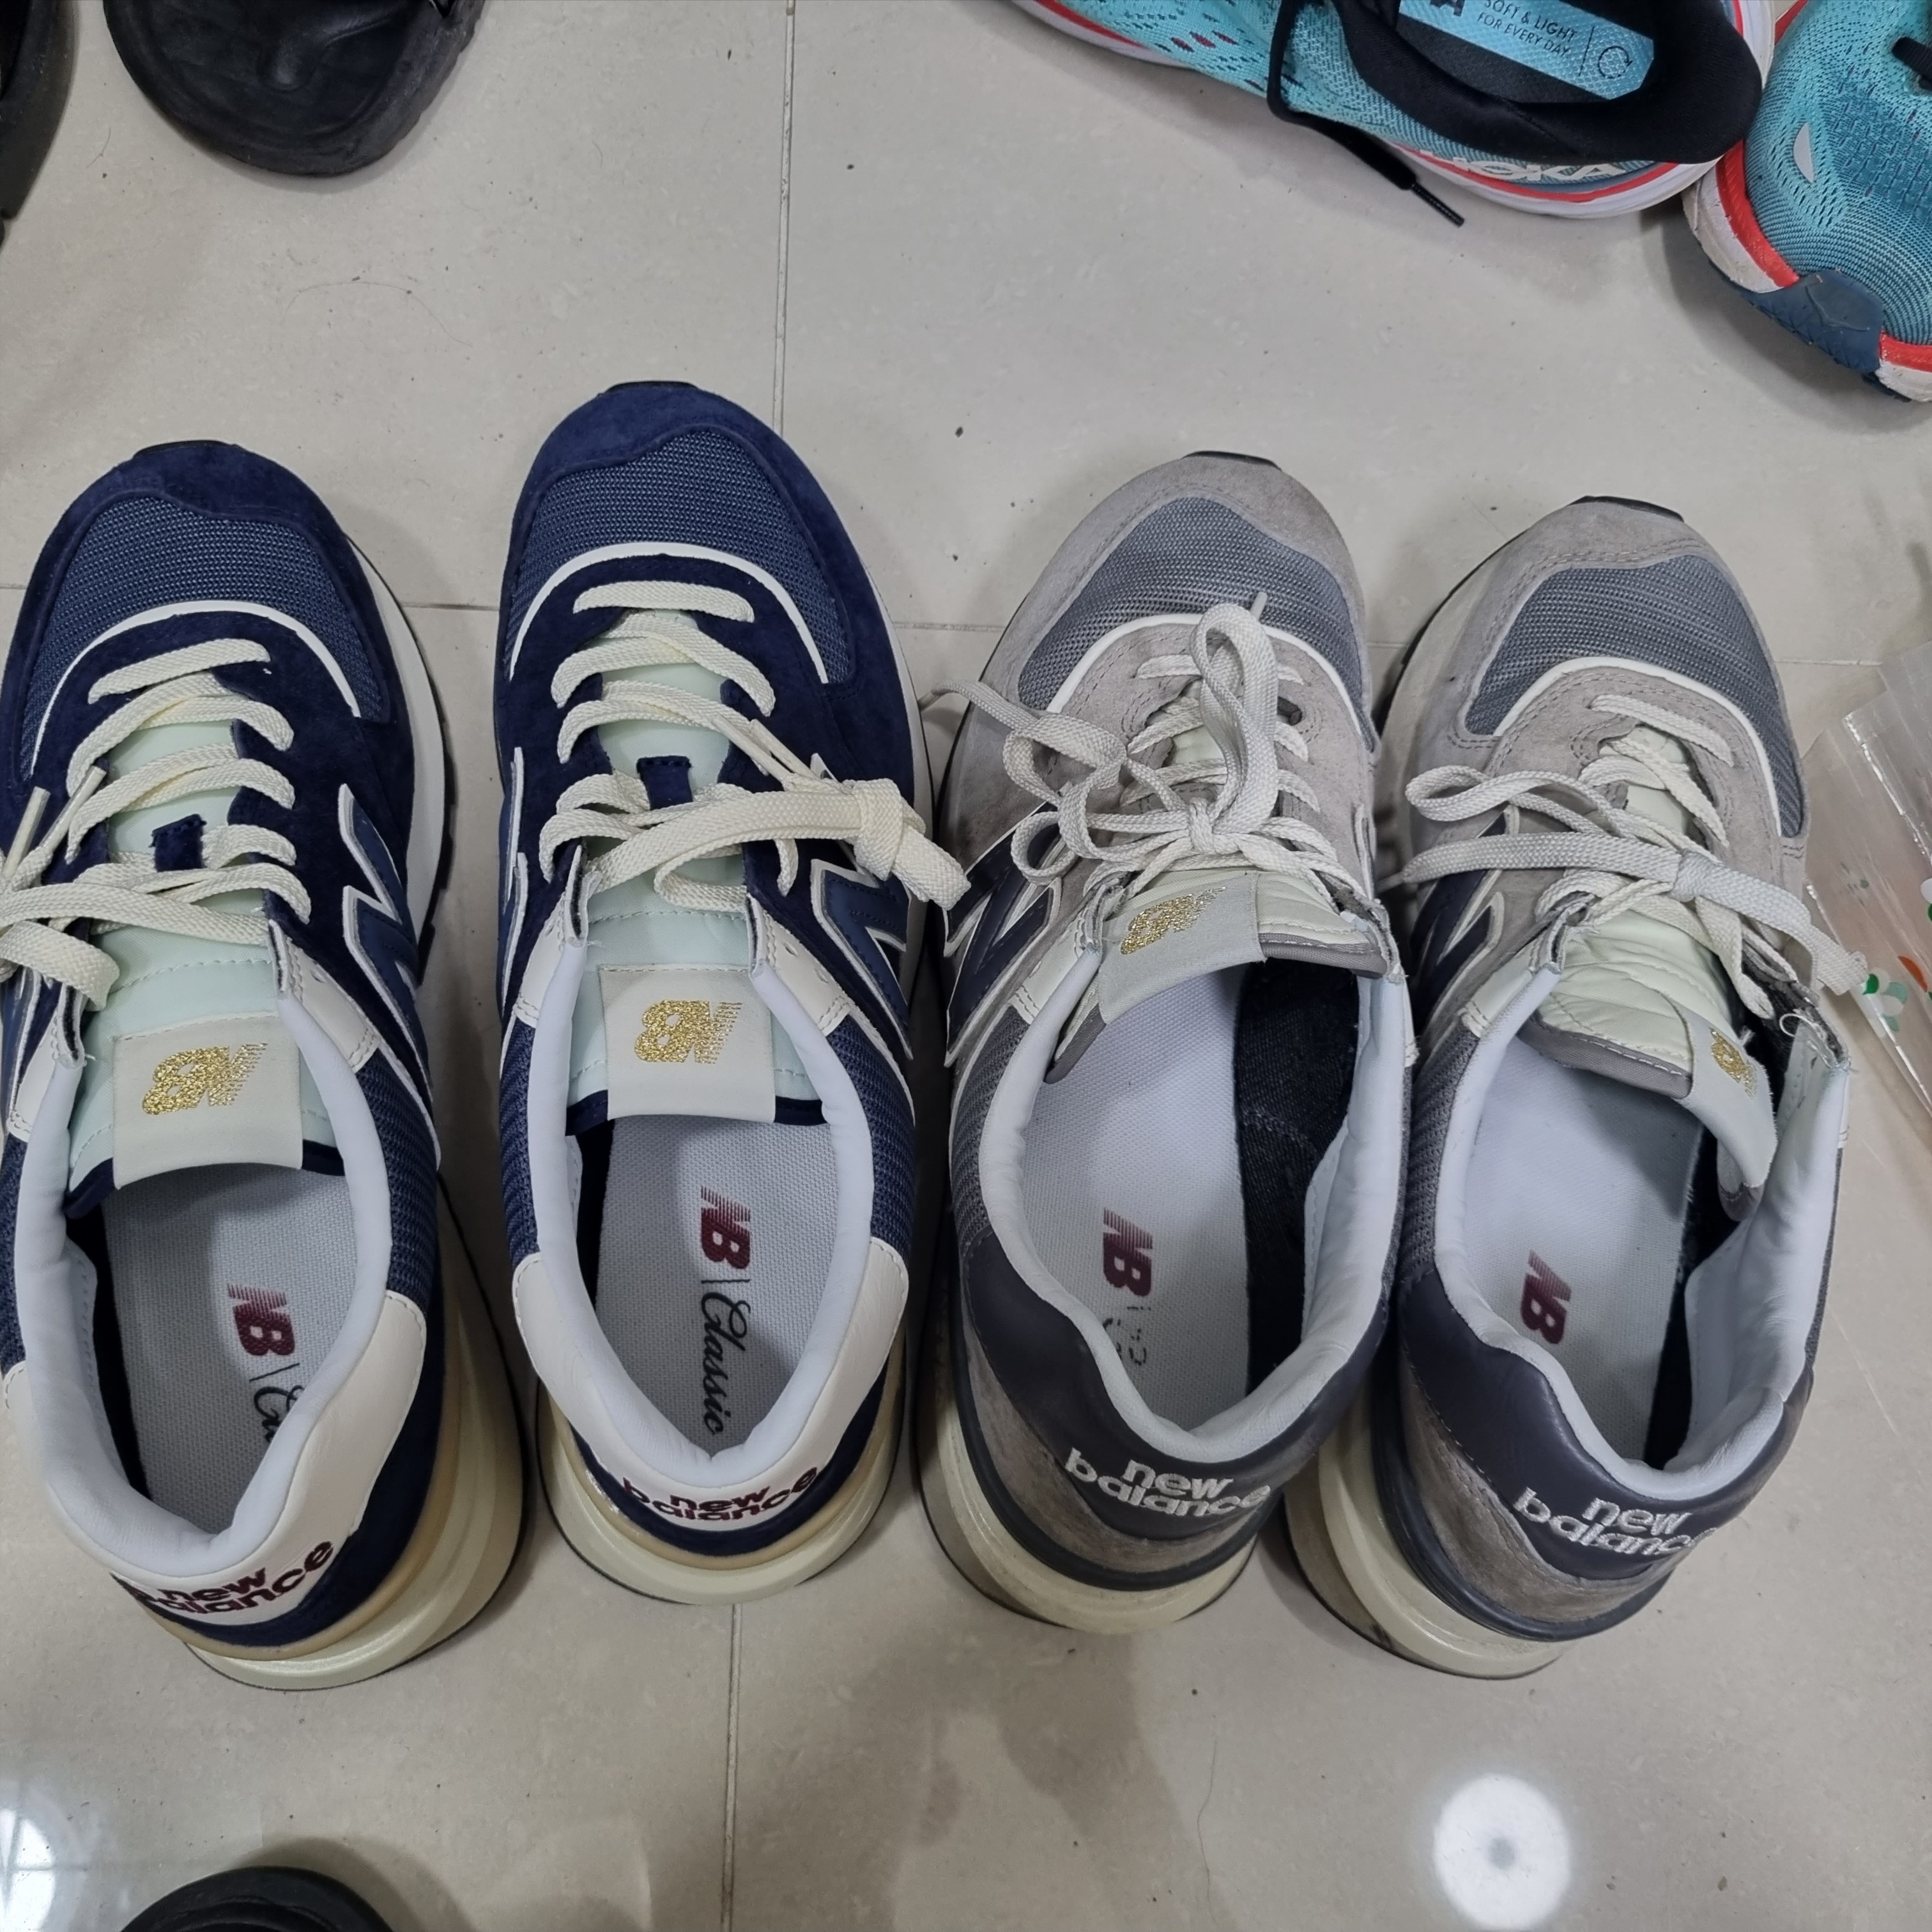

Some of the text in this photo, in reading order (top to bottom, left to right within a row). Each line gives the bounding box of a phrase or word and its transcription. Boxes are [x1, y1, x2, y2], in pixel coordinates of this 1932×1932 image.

[1477, 12, 1570, 57] FOR EVERY DAY
[1534, 15, 1577, 42] LIGHT
[1420, 150, 1625, 181] OKA
[1103, 1208, 1153, 1297] NB
[227, 1283, 296, 1356] NB
[701, 1186, 751, 1436] NB Classic
[1520, 1249, 1572, 1344] NB
[623, 1467, 818, 1521] balance
[670, 1486, 770, 1511] new
[1065, 1447, 1271, 1517] balance
[1121, 1460, 1234, 1499] new
[1514, 1487, 1716, 1556] balanc
[1581, 1498, 1692, 1535] new
[157, 1567, 266, 1601] new
